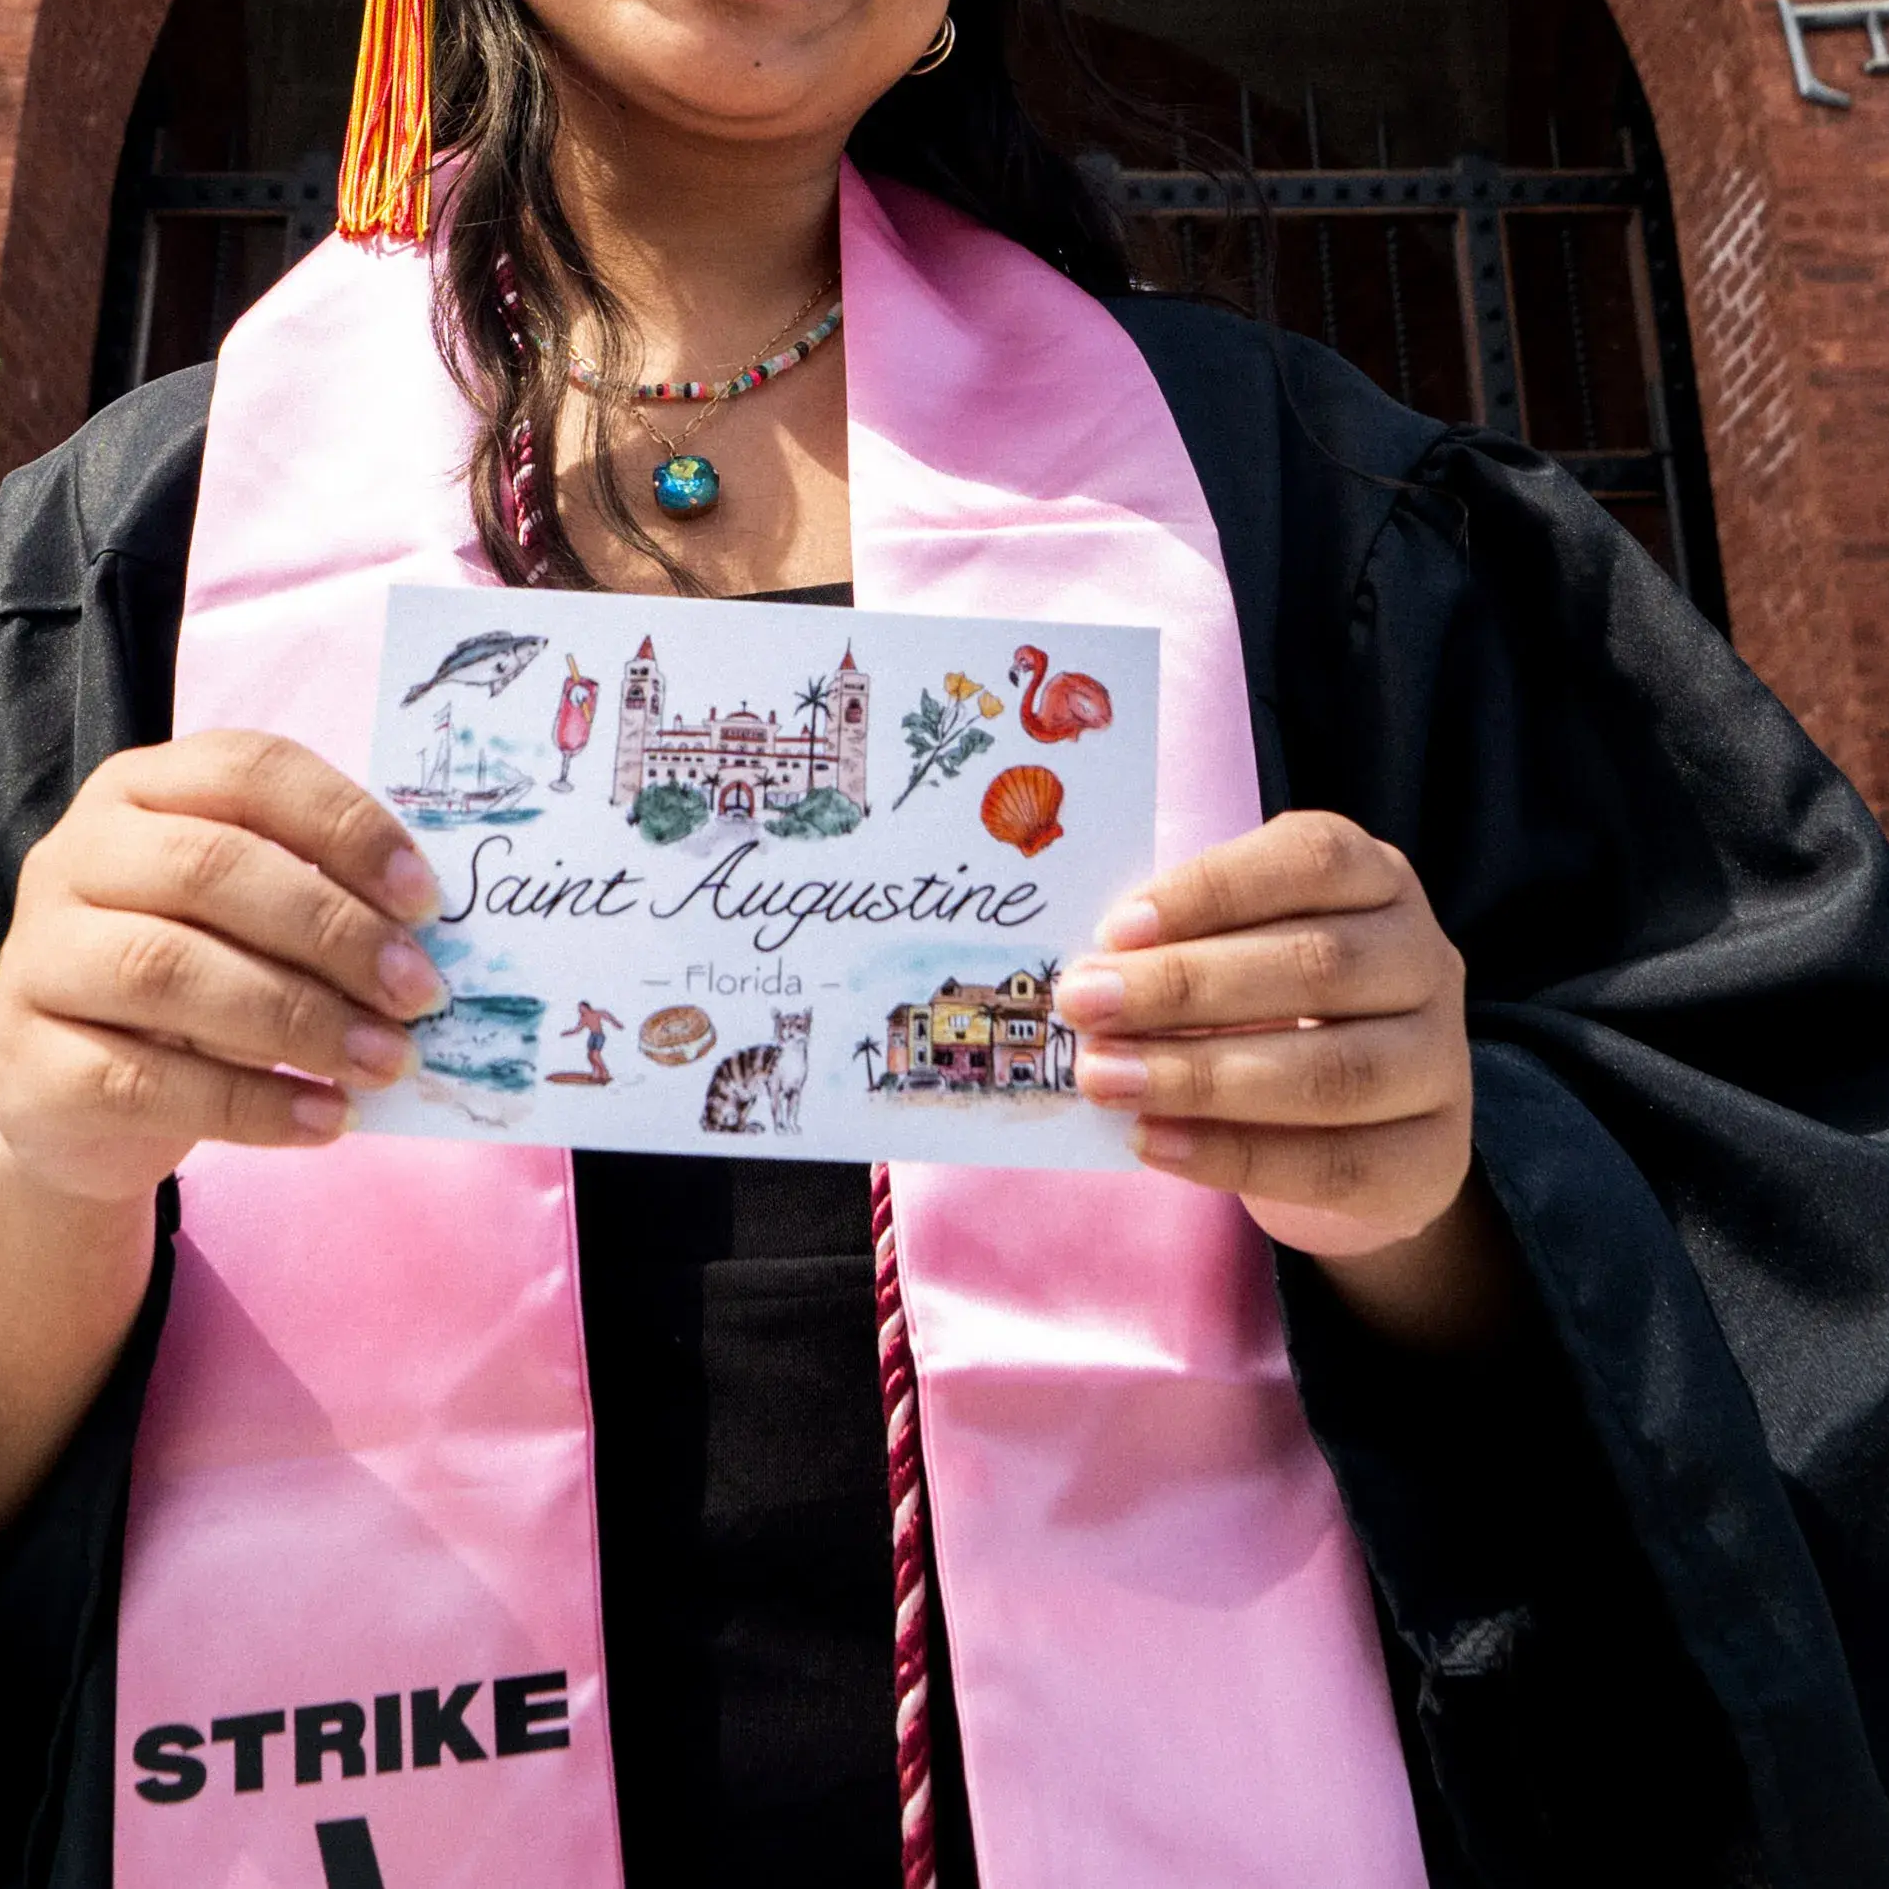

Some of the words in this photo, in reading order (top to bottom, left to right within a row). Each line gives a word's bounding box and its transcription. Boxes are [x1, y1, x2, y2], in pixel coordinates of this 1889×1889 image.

[441, 835, 644, 923] Saint
[650, 840, 1048, 953] Augustine
[684, 958, 804, 997] Florida
[132, 1670, 571, 1804] STRIKE
